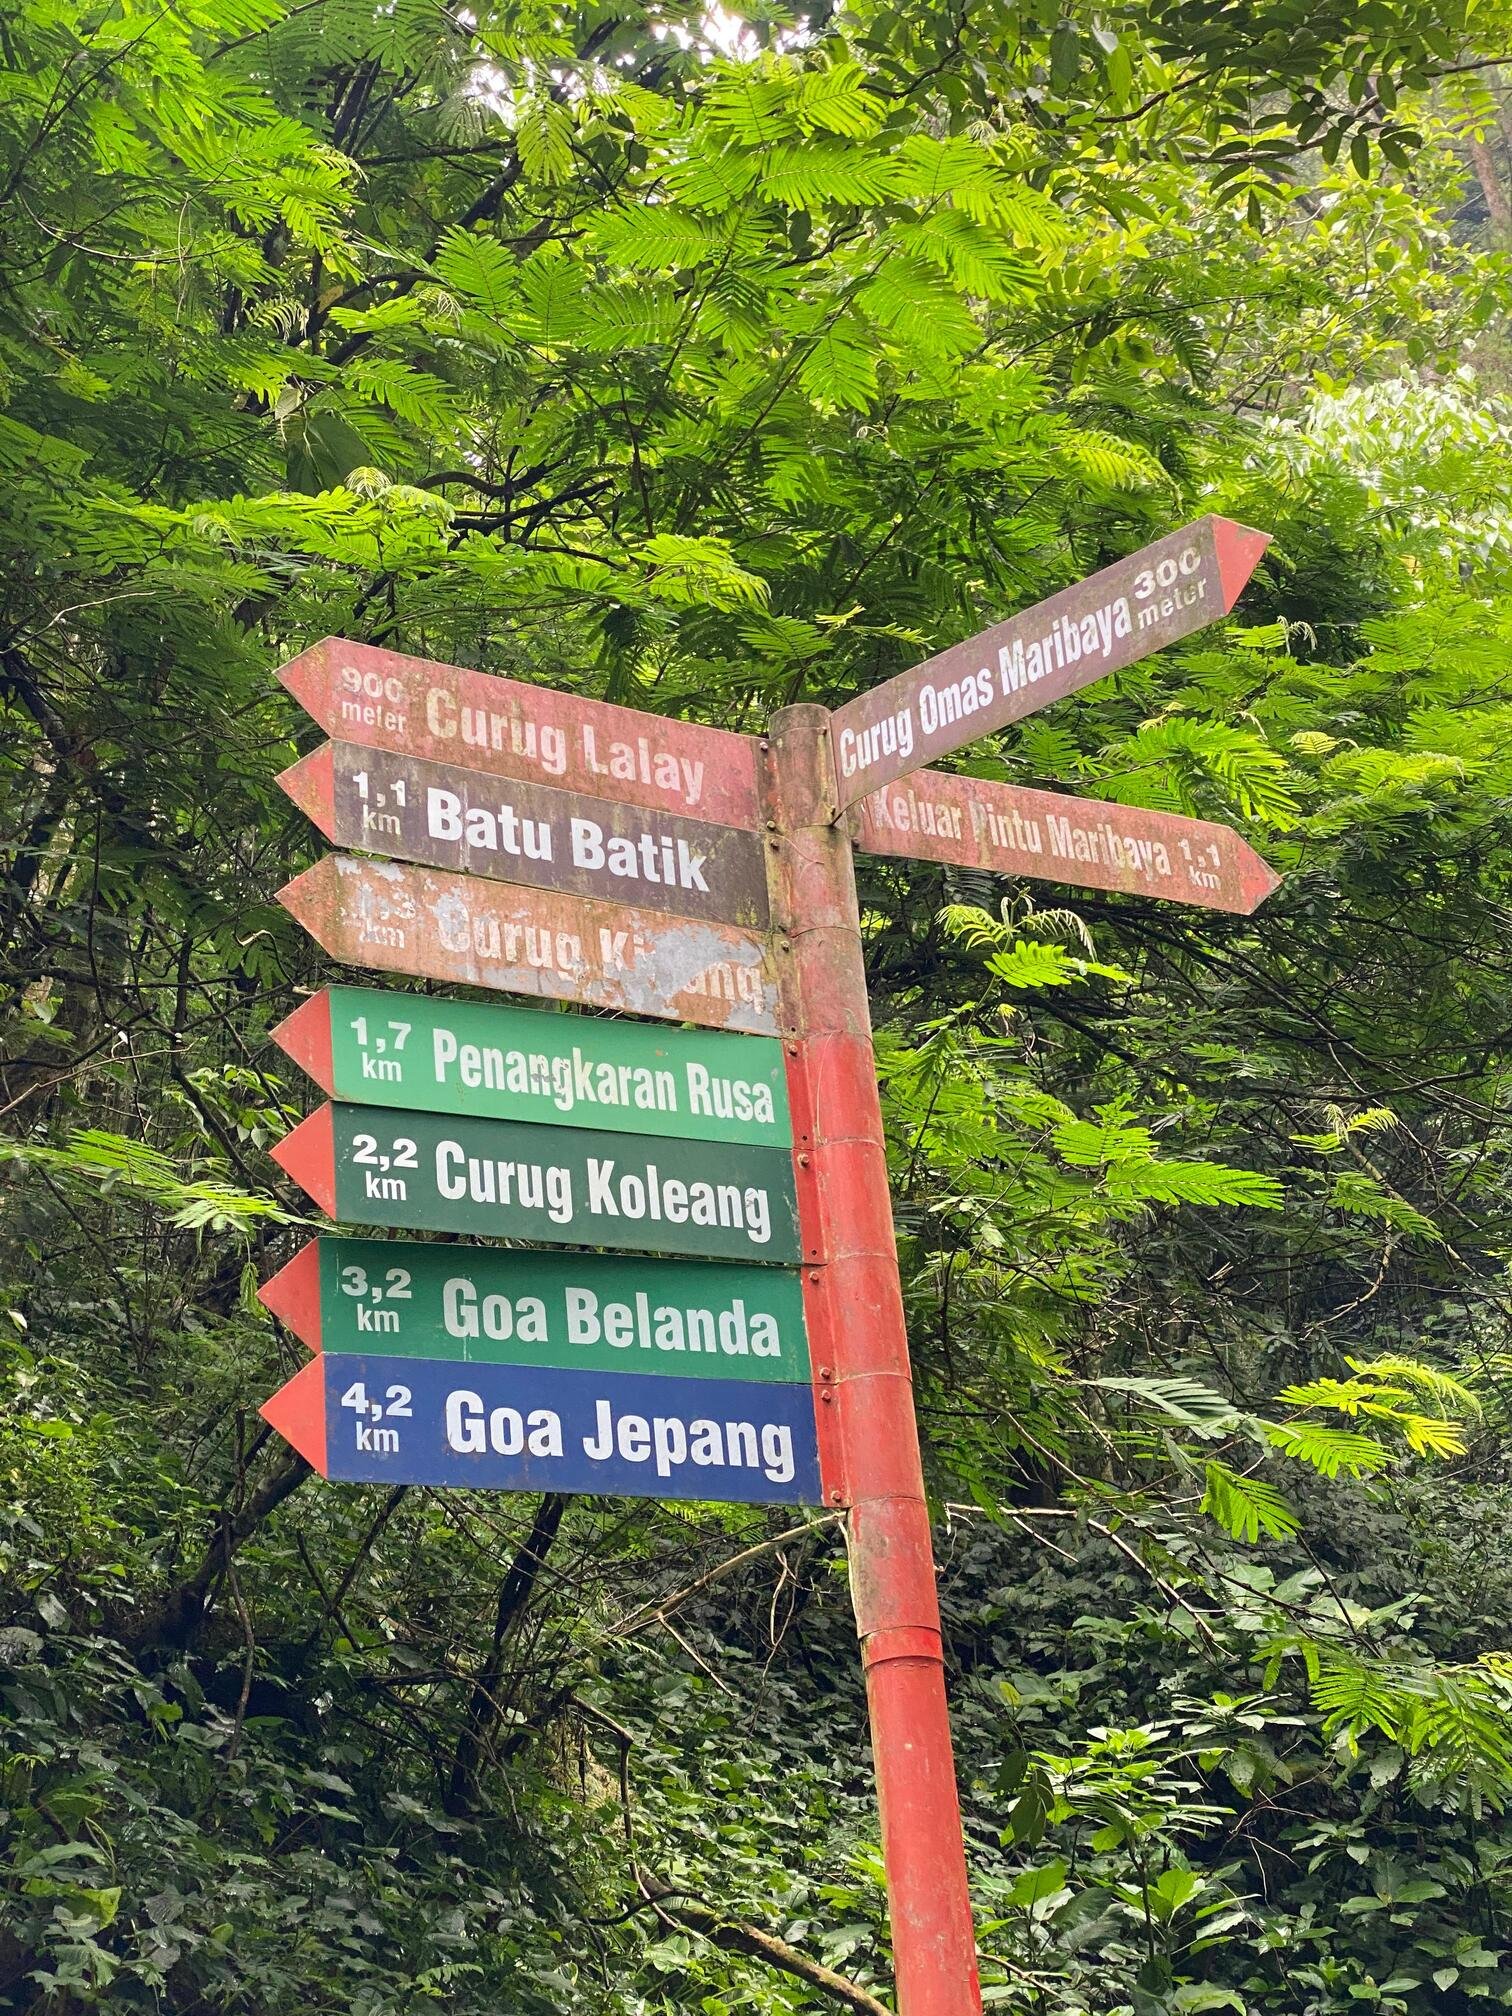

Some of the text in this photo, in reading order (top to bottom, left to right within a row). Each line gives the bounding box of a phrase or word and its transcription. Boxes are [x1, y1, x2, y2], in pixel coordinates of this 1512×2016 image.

[1137, 577, 1207, 630] meter
[341, 666, 404, 704] 900
[840, 596, 1133, 779] Curug Omas Maribaya
[426, 687, 704, 806] Curug Lalay
[352, 771, 406, 807] 1,1
[362, 804, 401, 835] km
[427, 786, 711, 893] Batu Batik
[1046, 814, 1172, 881] Maribaya
[1177, 838, 1221, 868] 1,1
[1189, 864, 1222, 890] km
[350, 1017, 412, 1052] 1,7
[361, 1051, 402, 1082] km
[432, 1028, 776, 1124] Penangkaran Rusa
[352, 1135, 419, 1173] 2,2
[365, 1171, 407, 1201] km
[435, 1140, 771, 1244] Curug Koleang
[342, 1266, 412, 1304] 3,2
[357, 1304, 400, 1333] km
[442, 1278, 782, 1358] Goa Belanda
[341, 1383, 413, 1423] 4,2
[355, 1422, 400, 1453] km
[445, 1390, 796, 1483] Goa Jepang
